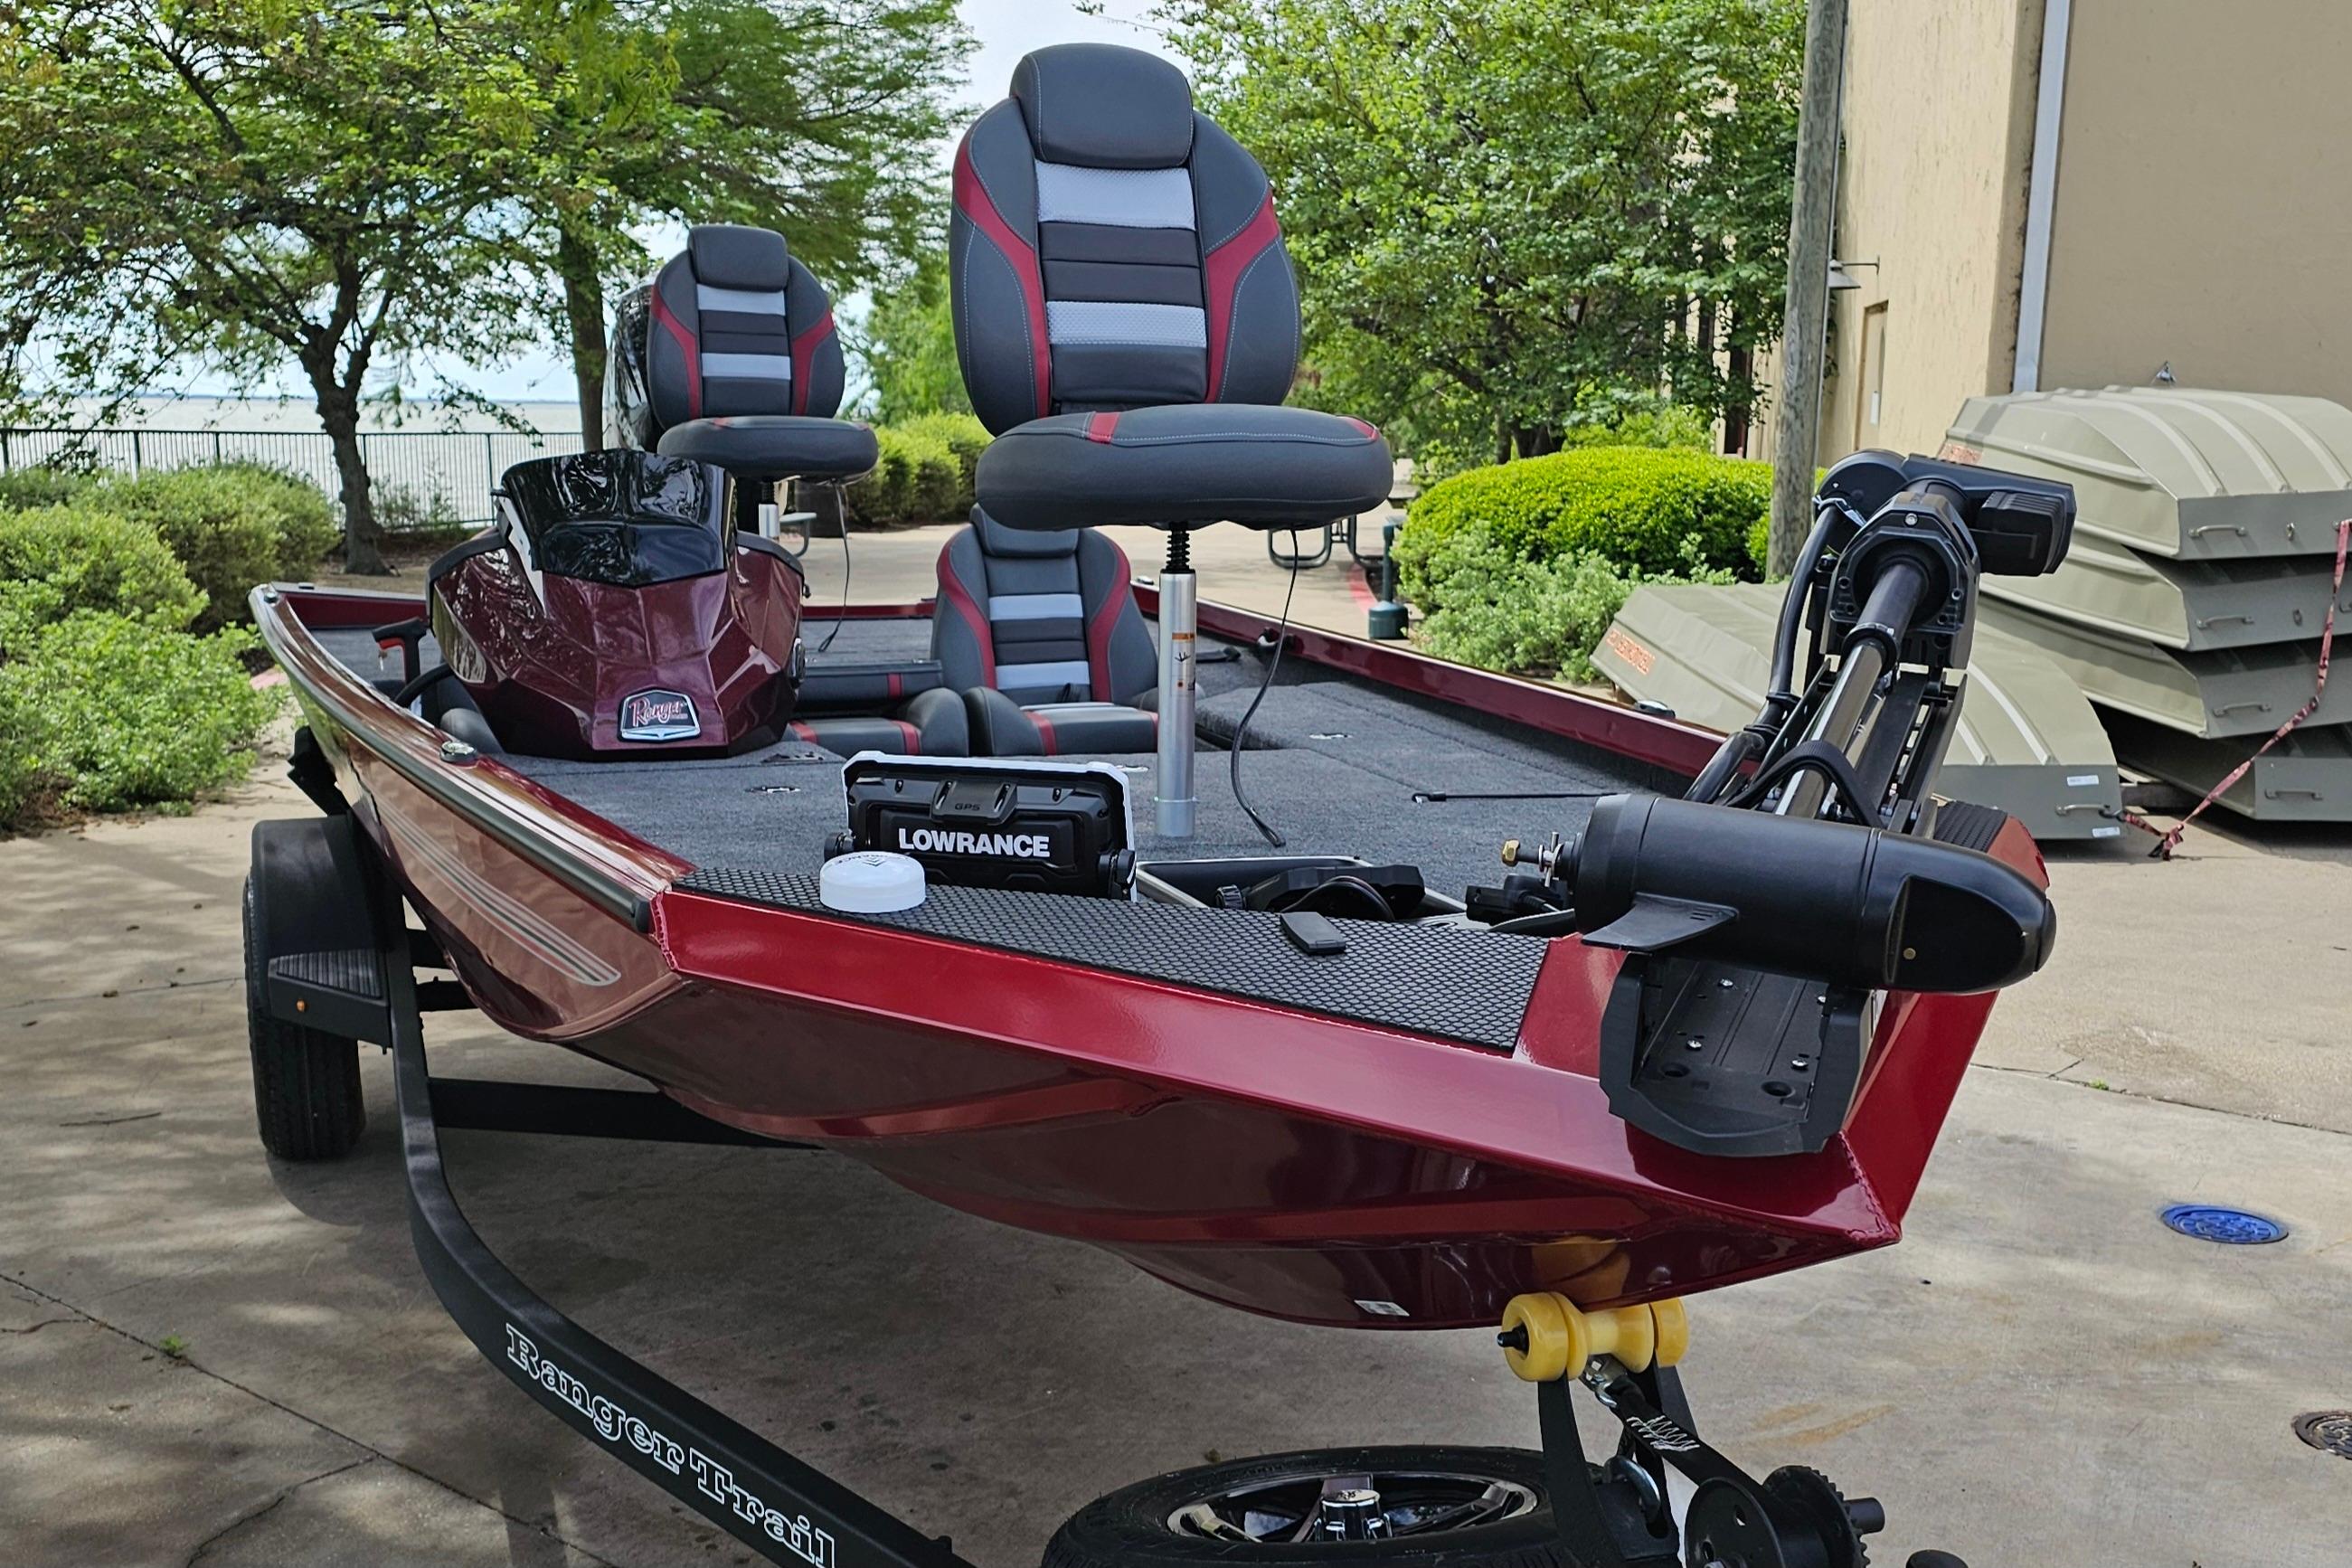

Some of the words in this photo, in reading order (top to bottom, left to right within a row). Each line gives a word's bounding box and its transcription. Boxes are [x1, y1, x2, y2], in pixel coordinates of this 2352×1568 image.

[955, 803, 980, 811] GPS
[898, 828, 1051, 858] LOWRANCE
[505, 1322, 685, 1475] Ranger
[689, 1447, 836, 1568] Trail
